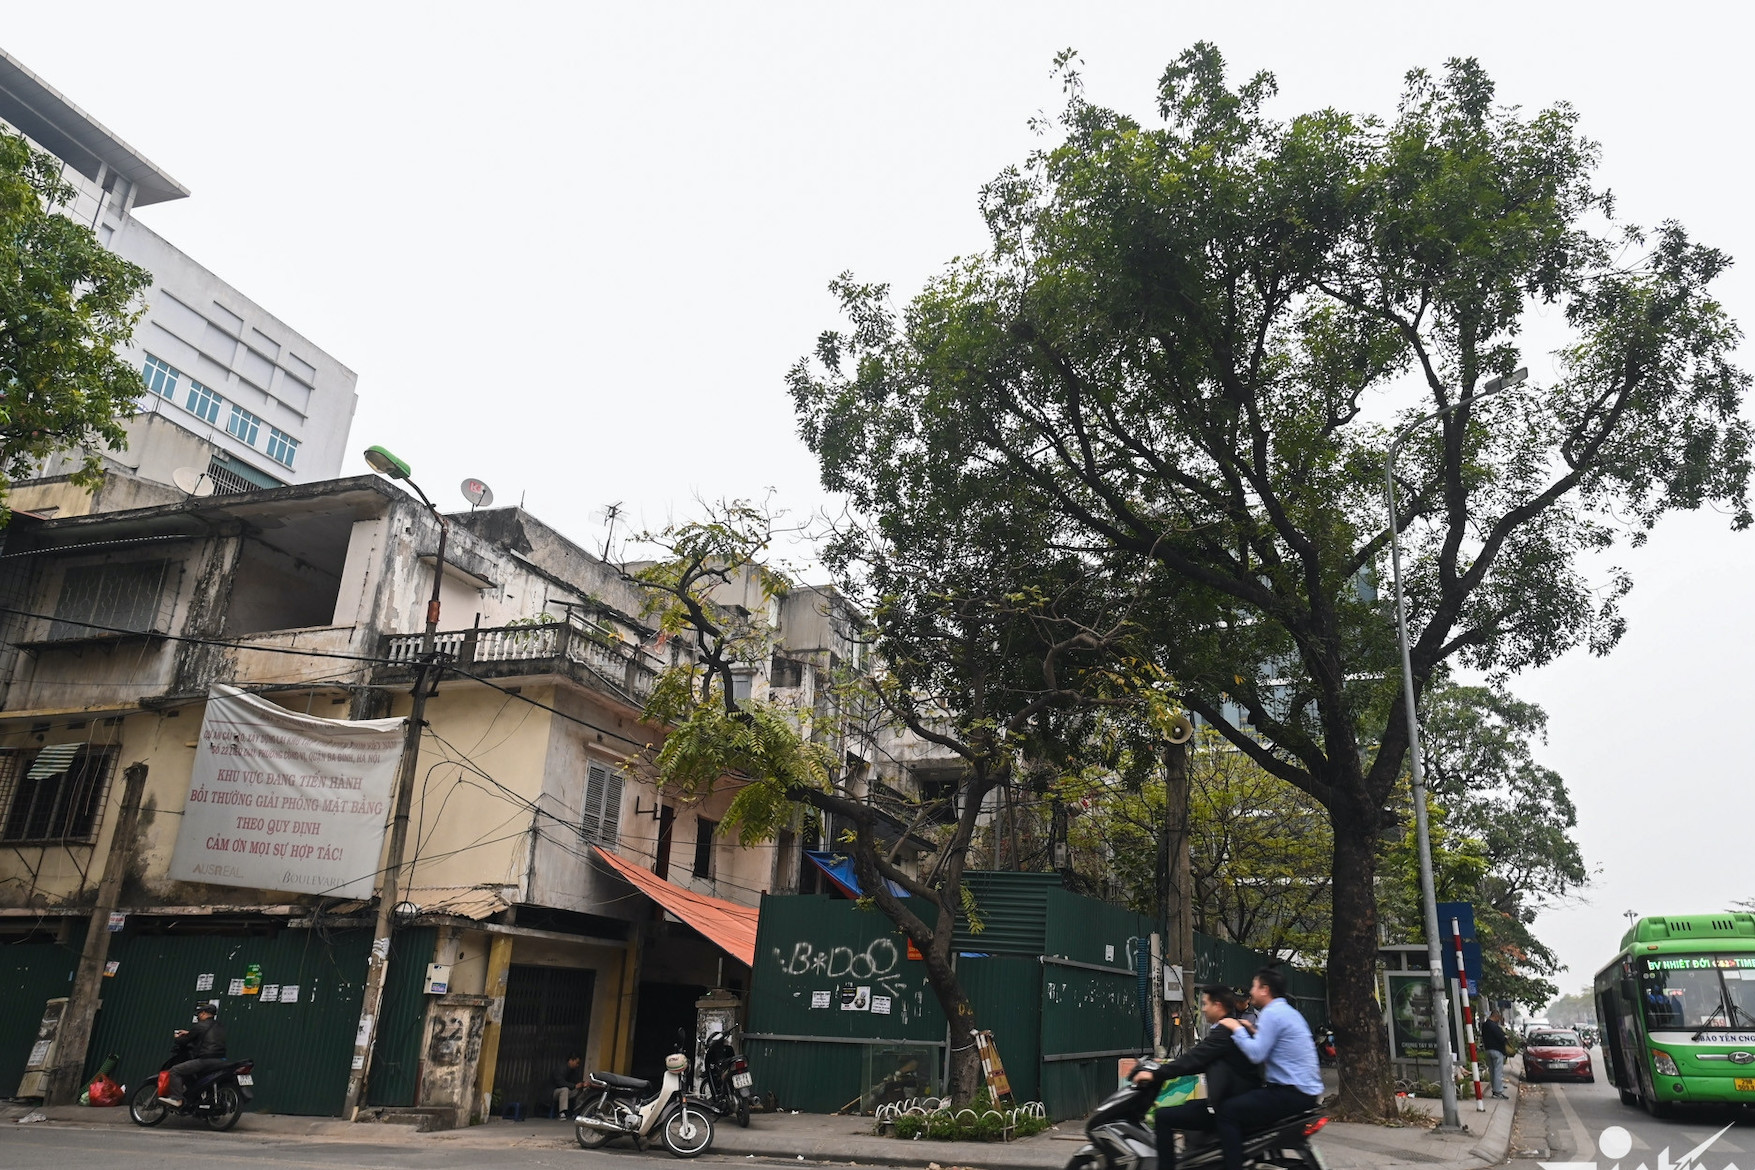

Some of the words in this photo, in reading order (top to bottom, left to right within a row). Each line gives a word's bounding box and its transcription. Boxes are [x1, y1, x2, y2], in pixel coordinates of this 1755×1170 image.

[217, 769, 240, 783] KHU
[243, 770, 264, 787] VỰC
[266, 773, 296, 787] ĐANG
[299, 770, 327, 788] TIẾN
[329, 773, 363, 790] HÀNH
[211, 790, 253, 807] THƯỜNG
[256, 791, 280, 808] GIẢI
[322, 797, 349, 815] MẶT
[237, 817, 265, 831] THEO
[267, 819, 291, 836] QUY
[292, 821, 322, 837] ĐỊNH
[206, 833, 231, 851] CẢM
[232, 838, 247, 853] ƠN
[249, 841, 271, 858] MỌI
[273, 842, 290, 860] SỰ
[291, 844, 315, 861] HỢP
[317, 844, 343, 860] TÁC!
[1647, 960, 1661, 971] BV
[1700, 1032, 1718, 1042] BẢO
